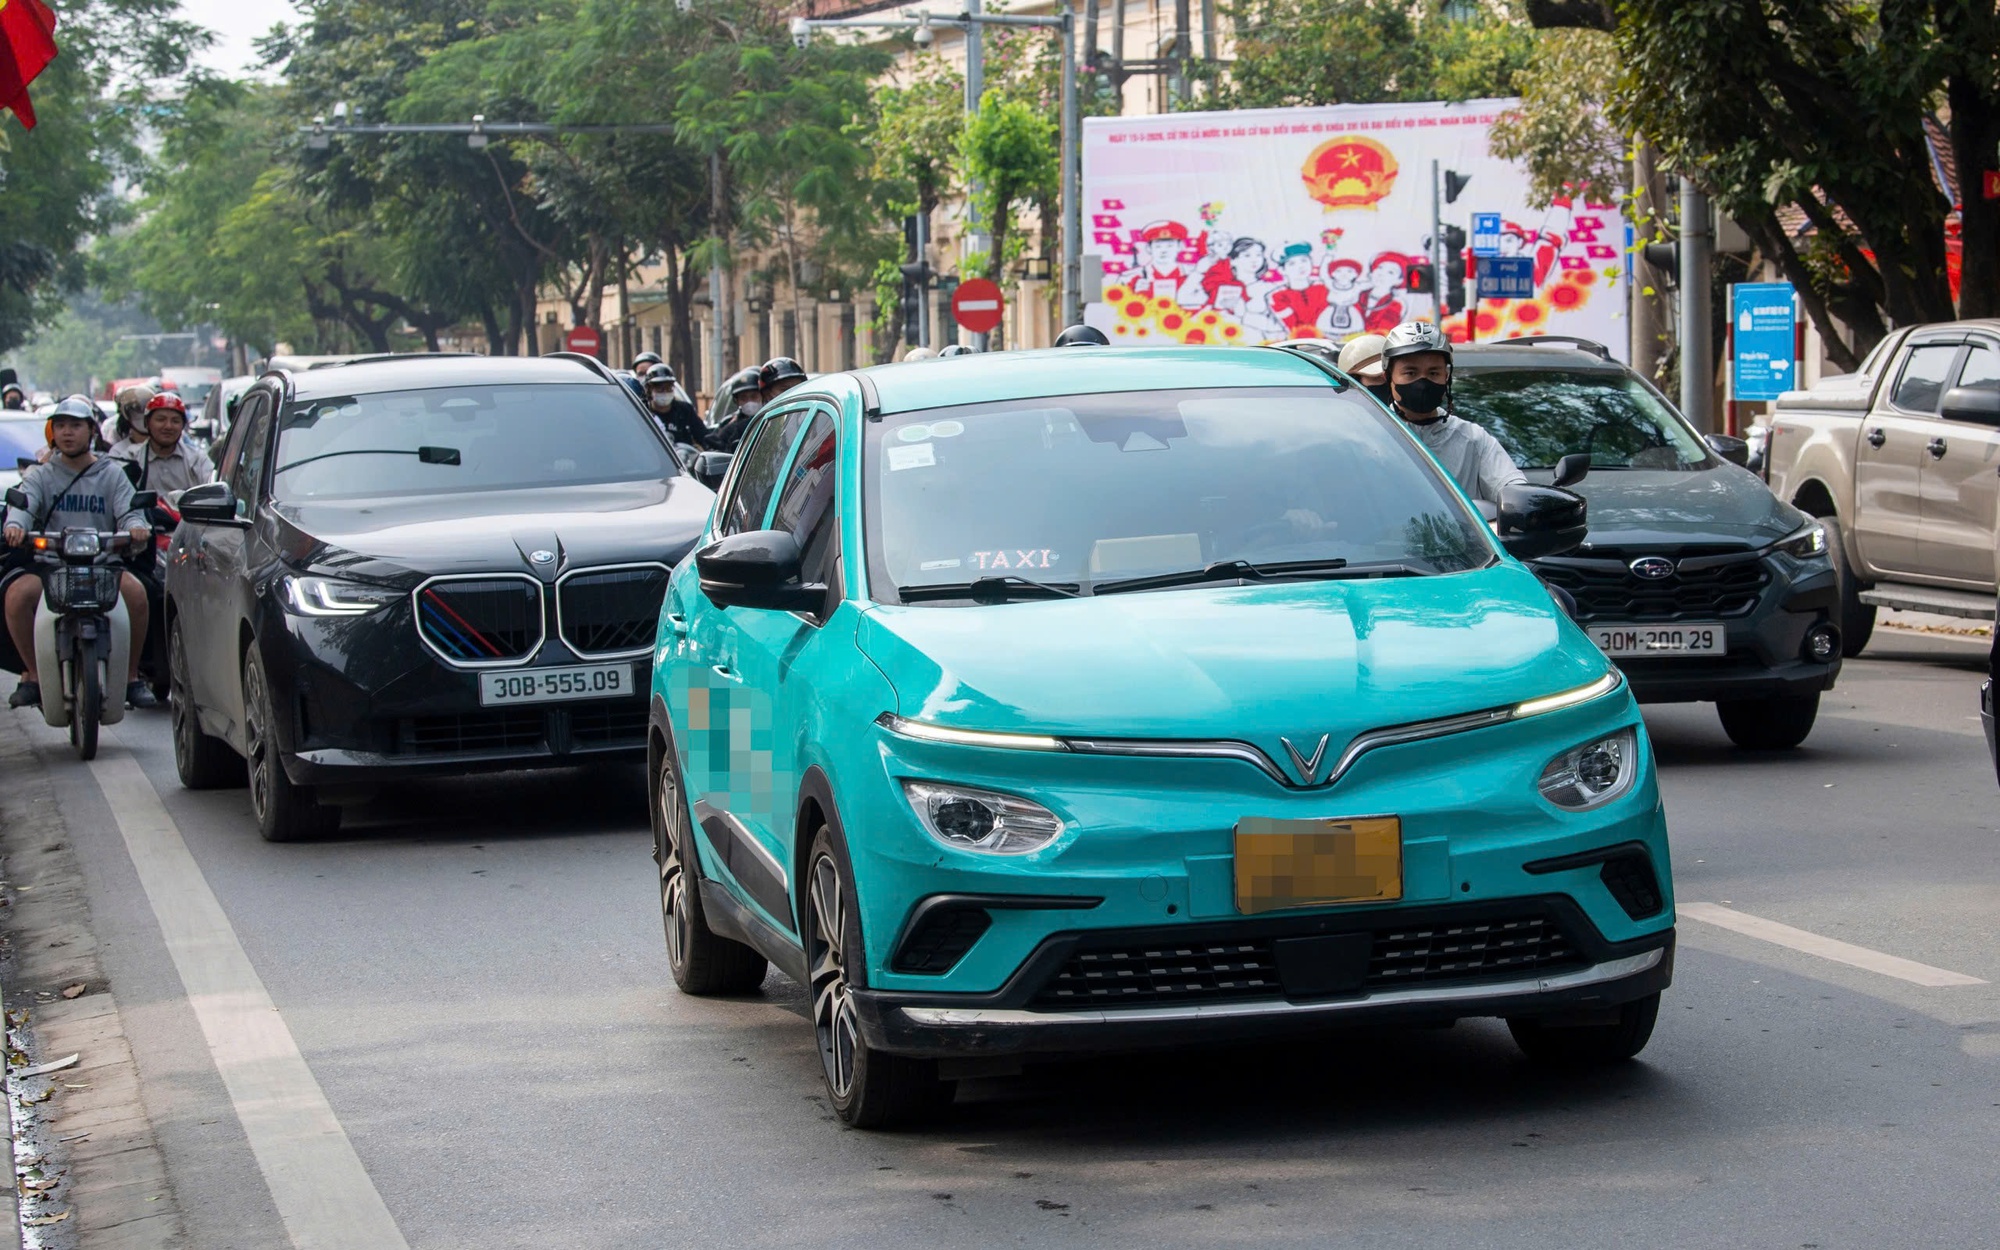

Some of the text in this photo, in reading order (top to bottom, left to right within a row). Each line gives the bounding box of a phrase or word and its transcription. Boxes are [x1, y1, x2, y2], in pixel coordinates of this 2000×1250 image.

[1482, 277, 1499, 292] CHU
[1519, 277, 1531, 292] AN
[974, 549, 1051, 570] TAXI
[1600, 630, 1714, 651] 30M-200.29
[494, 670, 620, 699] 30B-555.09
